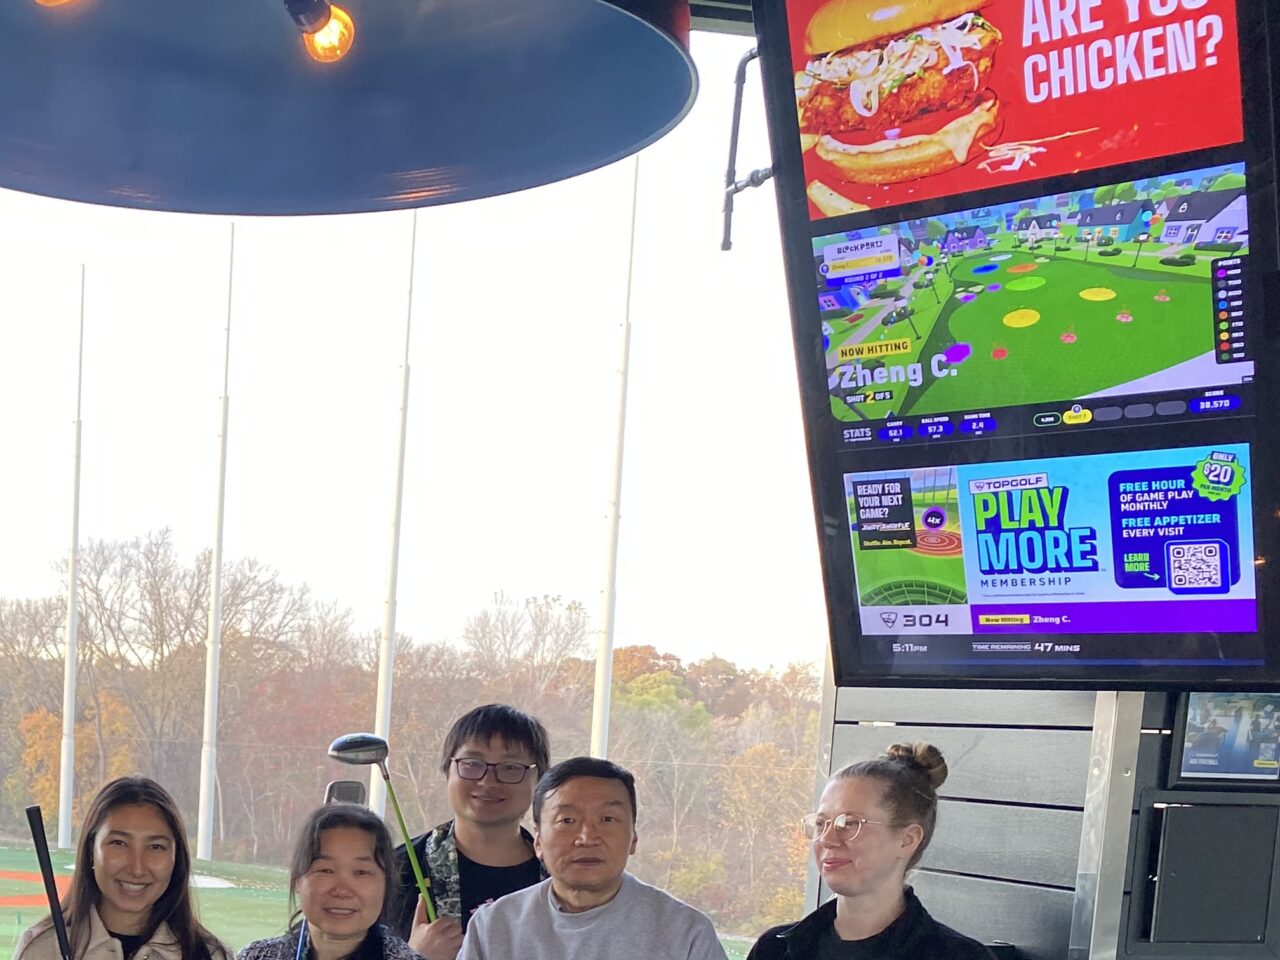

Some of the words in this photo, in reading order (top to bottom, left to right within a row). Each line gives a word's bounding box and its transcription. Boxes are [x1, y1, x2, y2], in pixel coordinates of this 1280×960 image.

[1022, 0, 1105, 48] ARE
[1023, 14, 1224, 104] CHICKEN?
[841, 346, 864, 358] NOW
[867, 341, 908, 354] HITTING
[840, 363, 923, 388] Zheng
[930, 353, 958, 378] C.
[846, 394, 865, 403] SHOT
[865, 391, 875, 404] 2
[875, 392, 885, 400] OF
[885, 391, 891, 399] 5
[843, 428, 872, 439] STATS
[927, 425, 943, 433] 57.3
[1212, 452, 1235, 462] ONLY
[1203, 462, 1232, 483] $20
[857, 484, 883, 495] READY
[884, 482, 902, 493] FOR
[985, 476, 1043, 490] TOPGOLF
[1119, 482, 1149, 493] FREE
[1151, 479, 1186, 491] HOUR
[858, 496, 880, 507] YOUR
[881, 494, 903, 506] NEXT
[1120, 493, 1133, 503] OF
[1135, 491, 1166, 502] GAME
[1167, 490, 1194, 500] PLAY
[973, 486, 1066, 531] PLAY
[1120, 500, 1169, 512] MONTHLY
[860, 508, 889, 519] GAME?
[1121, 517, 1151, 528] FREE
[1154, 513, 1221, 526] APPETIZER
[1122, 528, 1155, 538] EVERY
[1157, 526, 1185, 537] VISIT
[977, 527, 1097, 573] MORE
[1123, 552, 1150, 562] LEARN
[1124, 562, 1151, 573] MORE
[980, 576, 1072, 588] MEMBERSHIP
[902, 613, 949, 628] 304
[1001, 616, 1024, 624] Hitting
[1032, 615, 1060, 625] Zheng
[1061, 614, 1072, 624] C.
[972, 643, 990, 651] TIME
[990, 643, 1032, 651] REMAINING
[1034, 642, 1053, 653] 47
[1054, 644, 1081, 653] MINS
